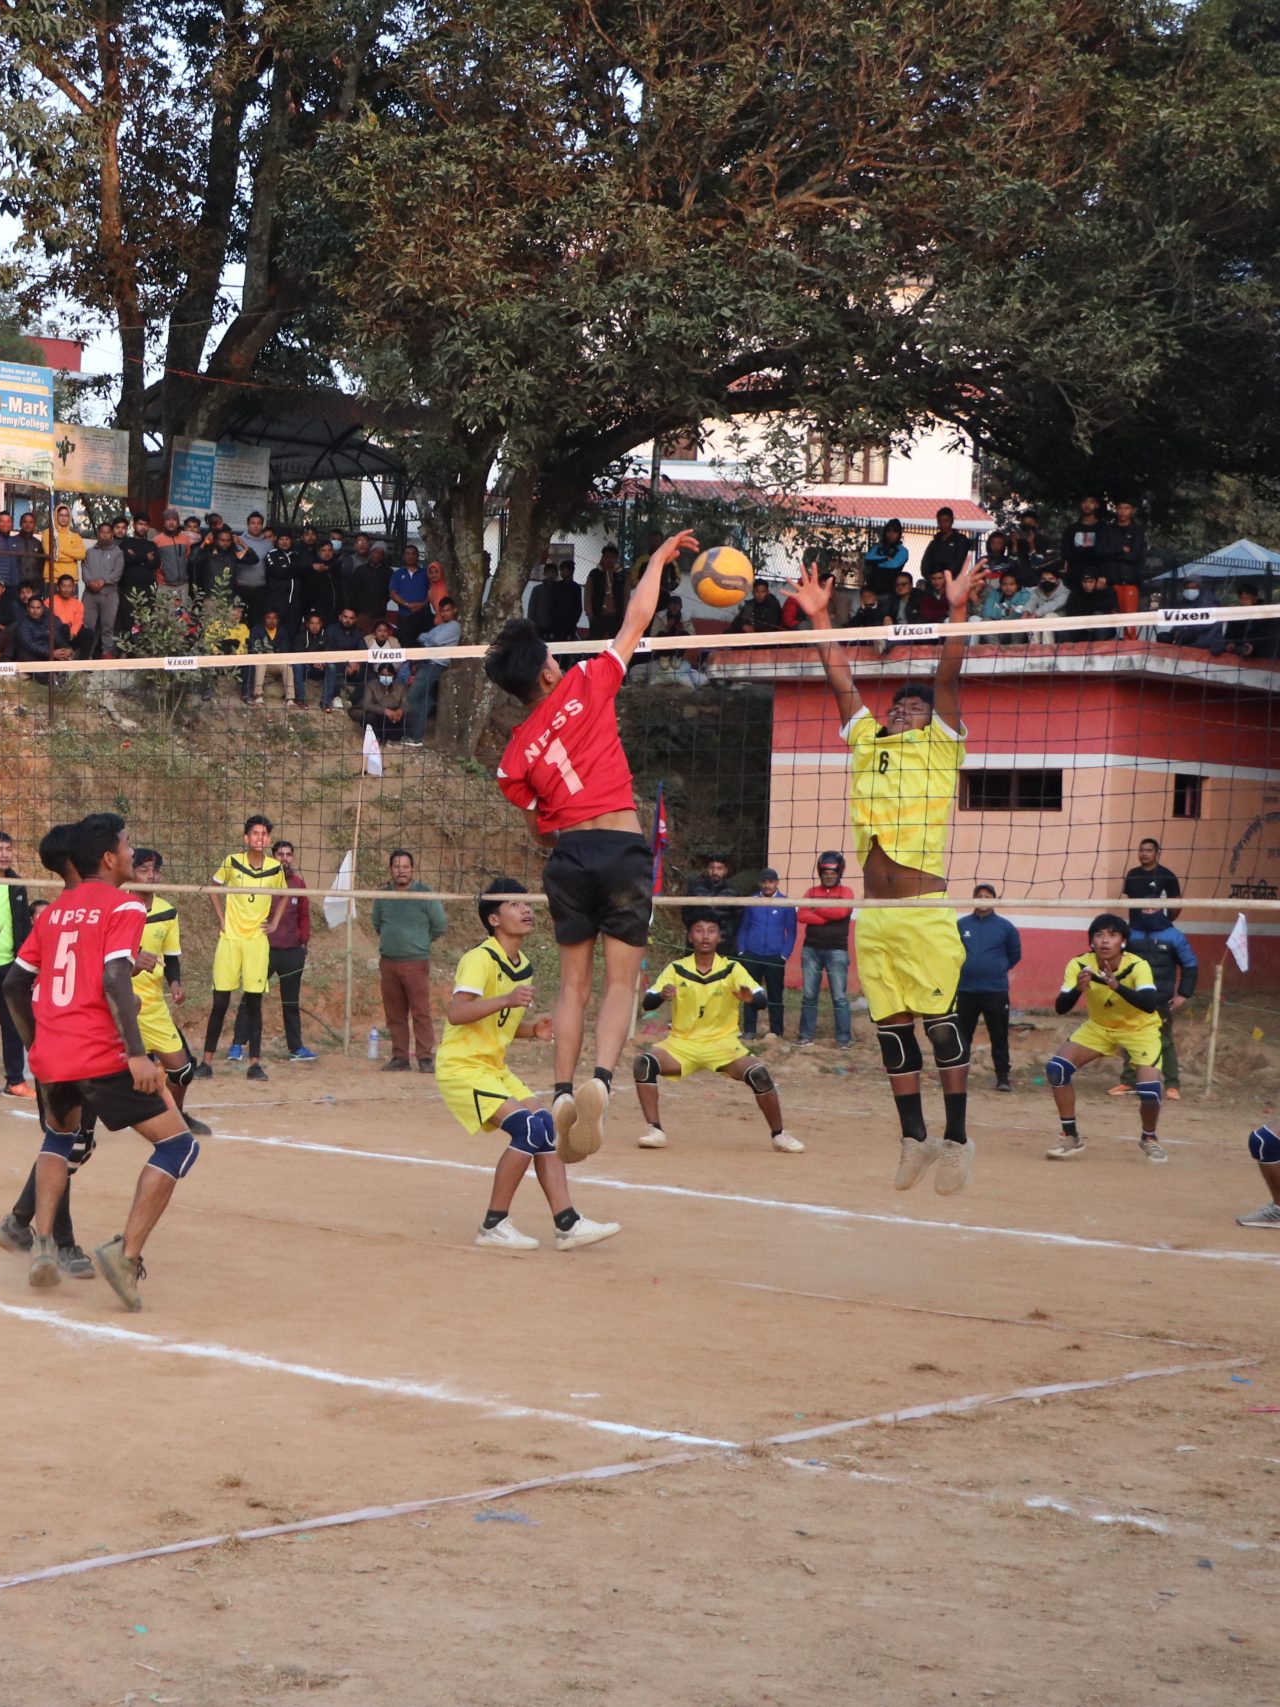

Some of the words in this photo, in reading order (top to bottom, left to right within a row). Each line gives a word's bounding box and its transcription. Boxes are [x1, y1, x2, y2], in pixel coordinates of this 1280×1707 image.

[1163, 610, 1210, 621] Vixen
[893, 626, 933, 637] Vixen
[167, 657, 194, 666] Vixen
[372, 650, 402, 660] Vixen
[543, 737, 585, 796] 1
[879, 751, 889, 775] 6
[49, 908, 102, 926] NPSS
[52, 930, 79, 1007] 5
[498, 1007, 511, 1027] 9
[699, 1006, 706, 1019] 5
